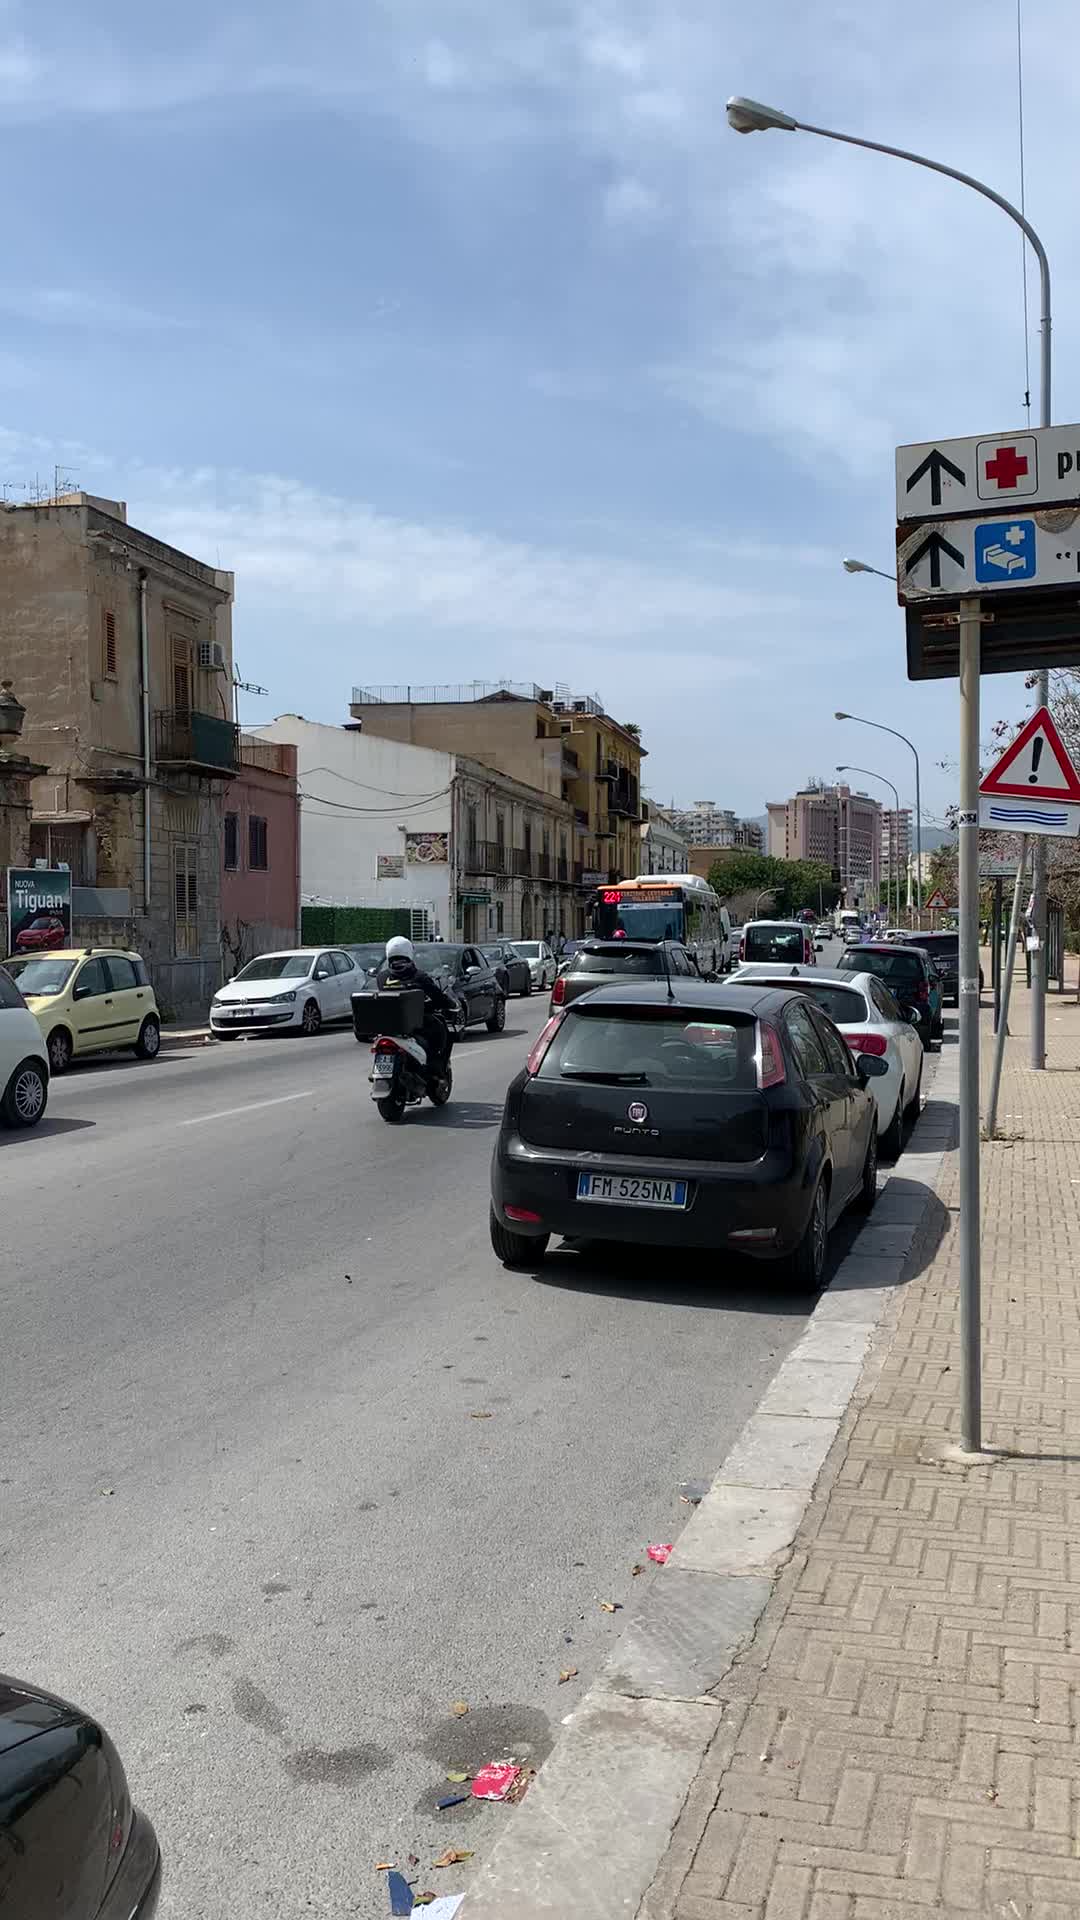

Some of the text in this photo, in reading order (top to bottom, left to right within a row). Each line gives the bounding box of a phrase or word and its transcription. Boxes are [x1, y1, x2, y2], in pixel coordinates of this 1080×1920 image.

[15, 880, 35, 888] NUOVA
[15, 889, 63, 913] Tiguan
[614, 1126, 660, 1136] PUNTO
